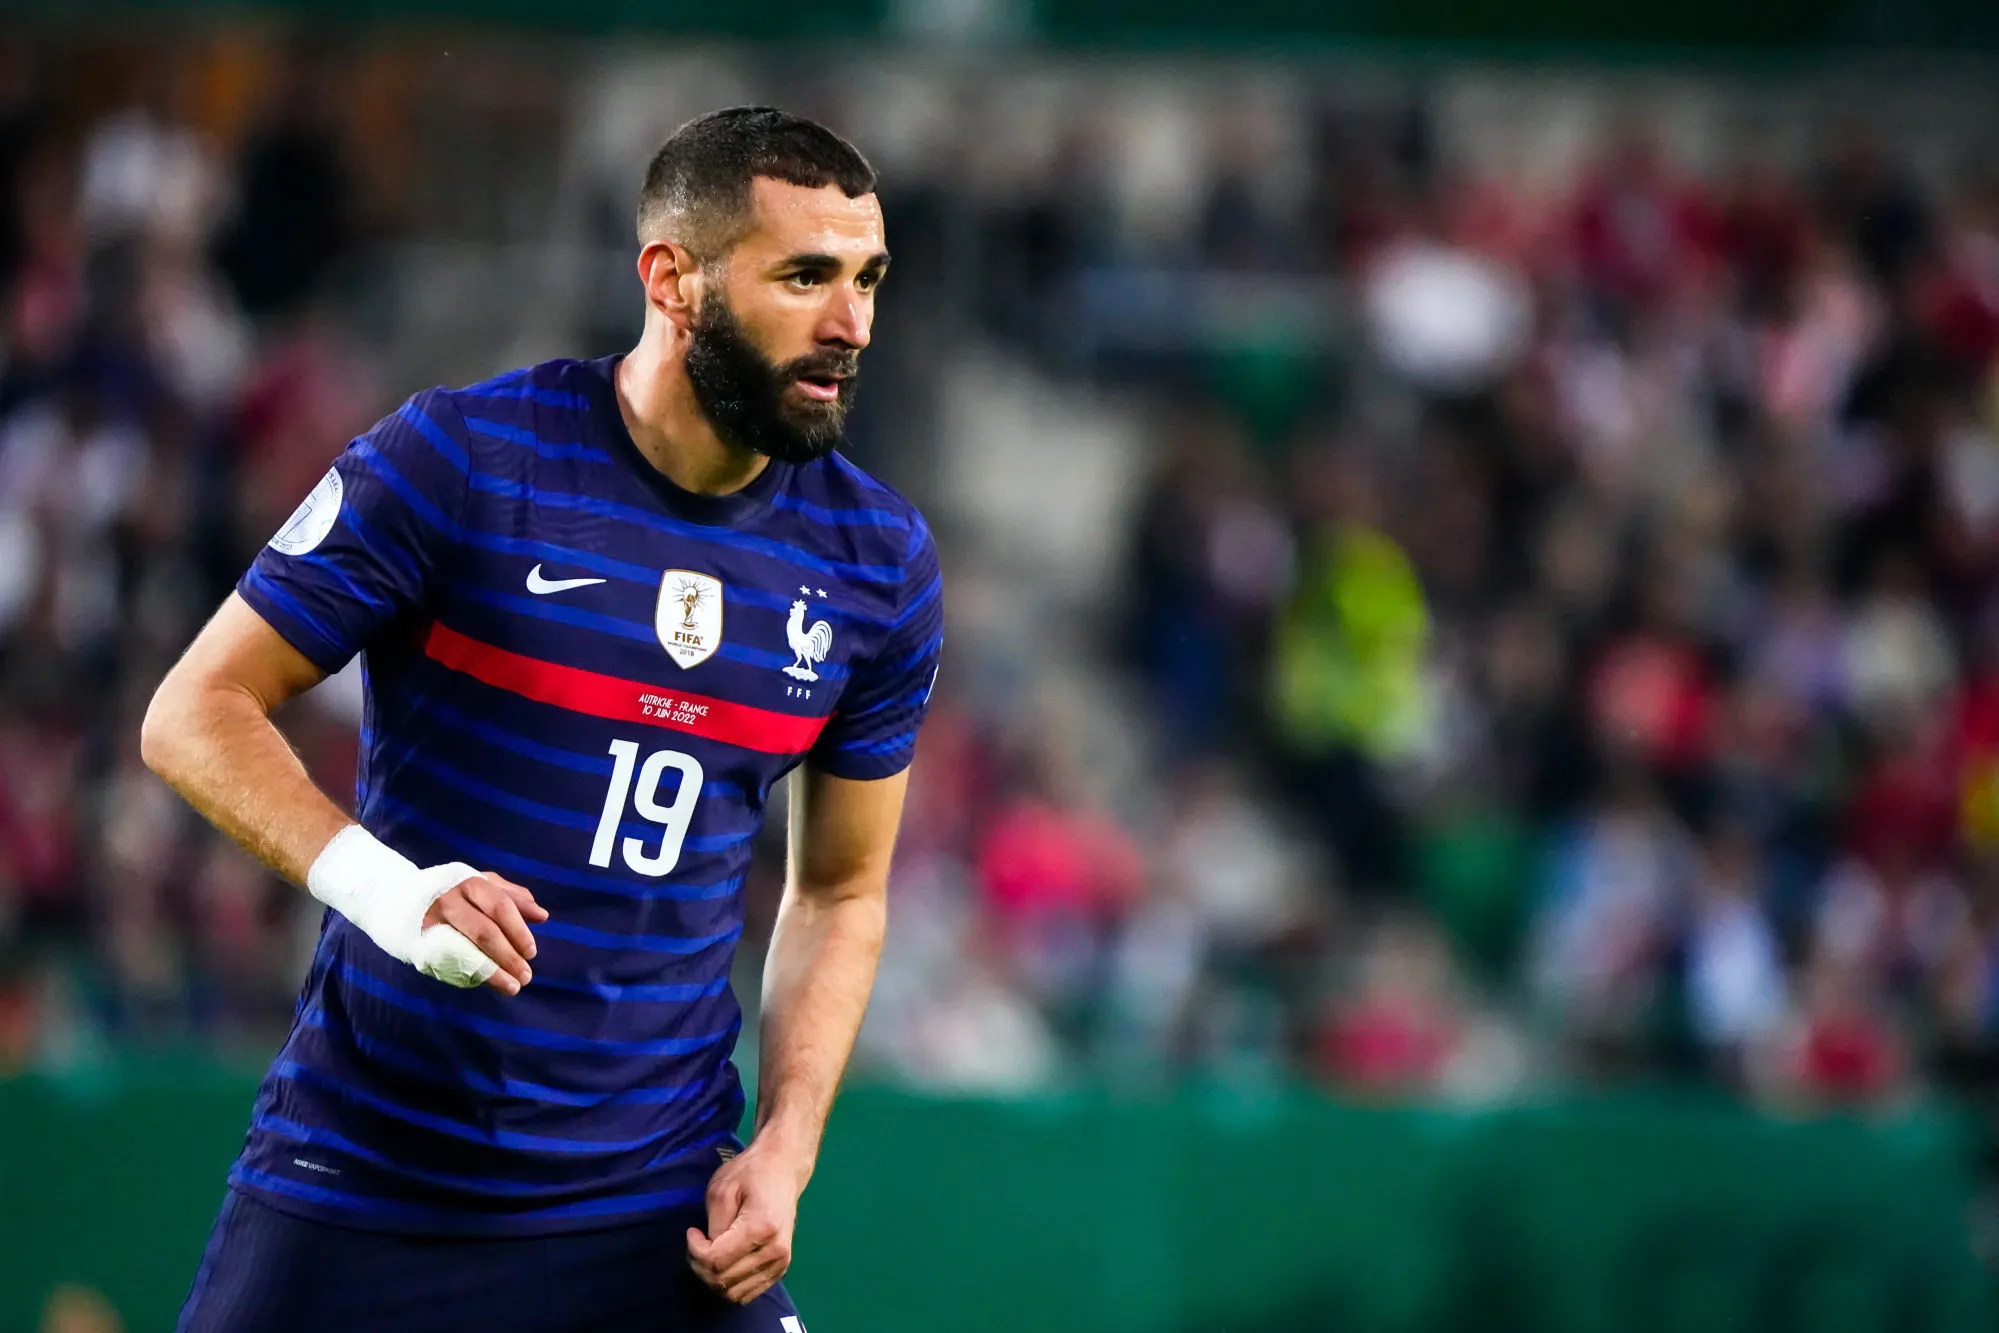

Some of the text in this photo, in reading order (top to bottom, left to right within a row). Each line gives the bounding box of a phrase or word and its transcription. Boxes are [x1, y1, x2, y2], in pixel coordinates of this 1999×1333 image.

[674, 631, 701, 646] FIFA
[679, 648, 695, 657] 2018
[638, 693, 673, 708] AUTRICHE
[679, 701, 709, 716] FRANCE
[642, 704, 696, 724] 10 JUIN 2022
[588, 738, 704, 878] 19
[293, 1158, 308, 1168] NIKE
